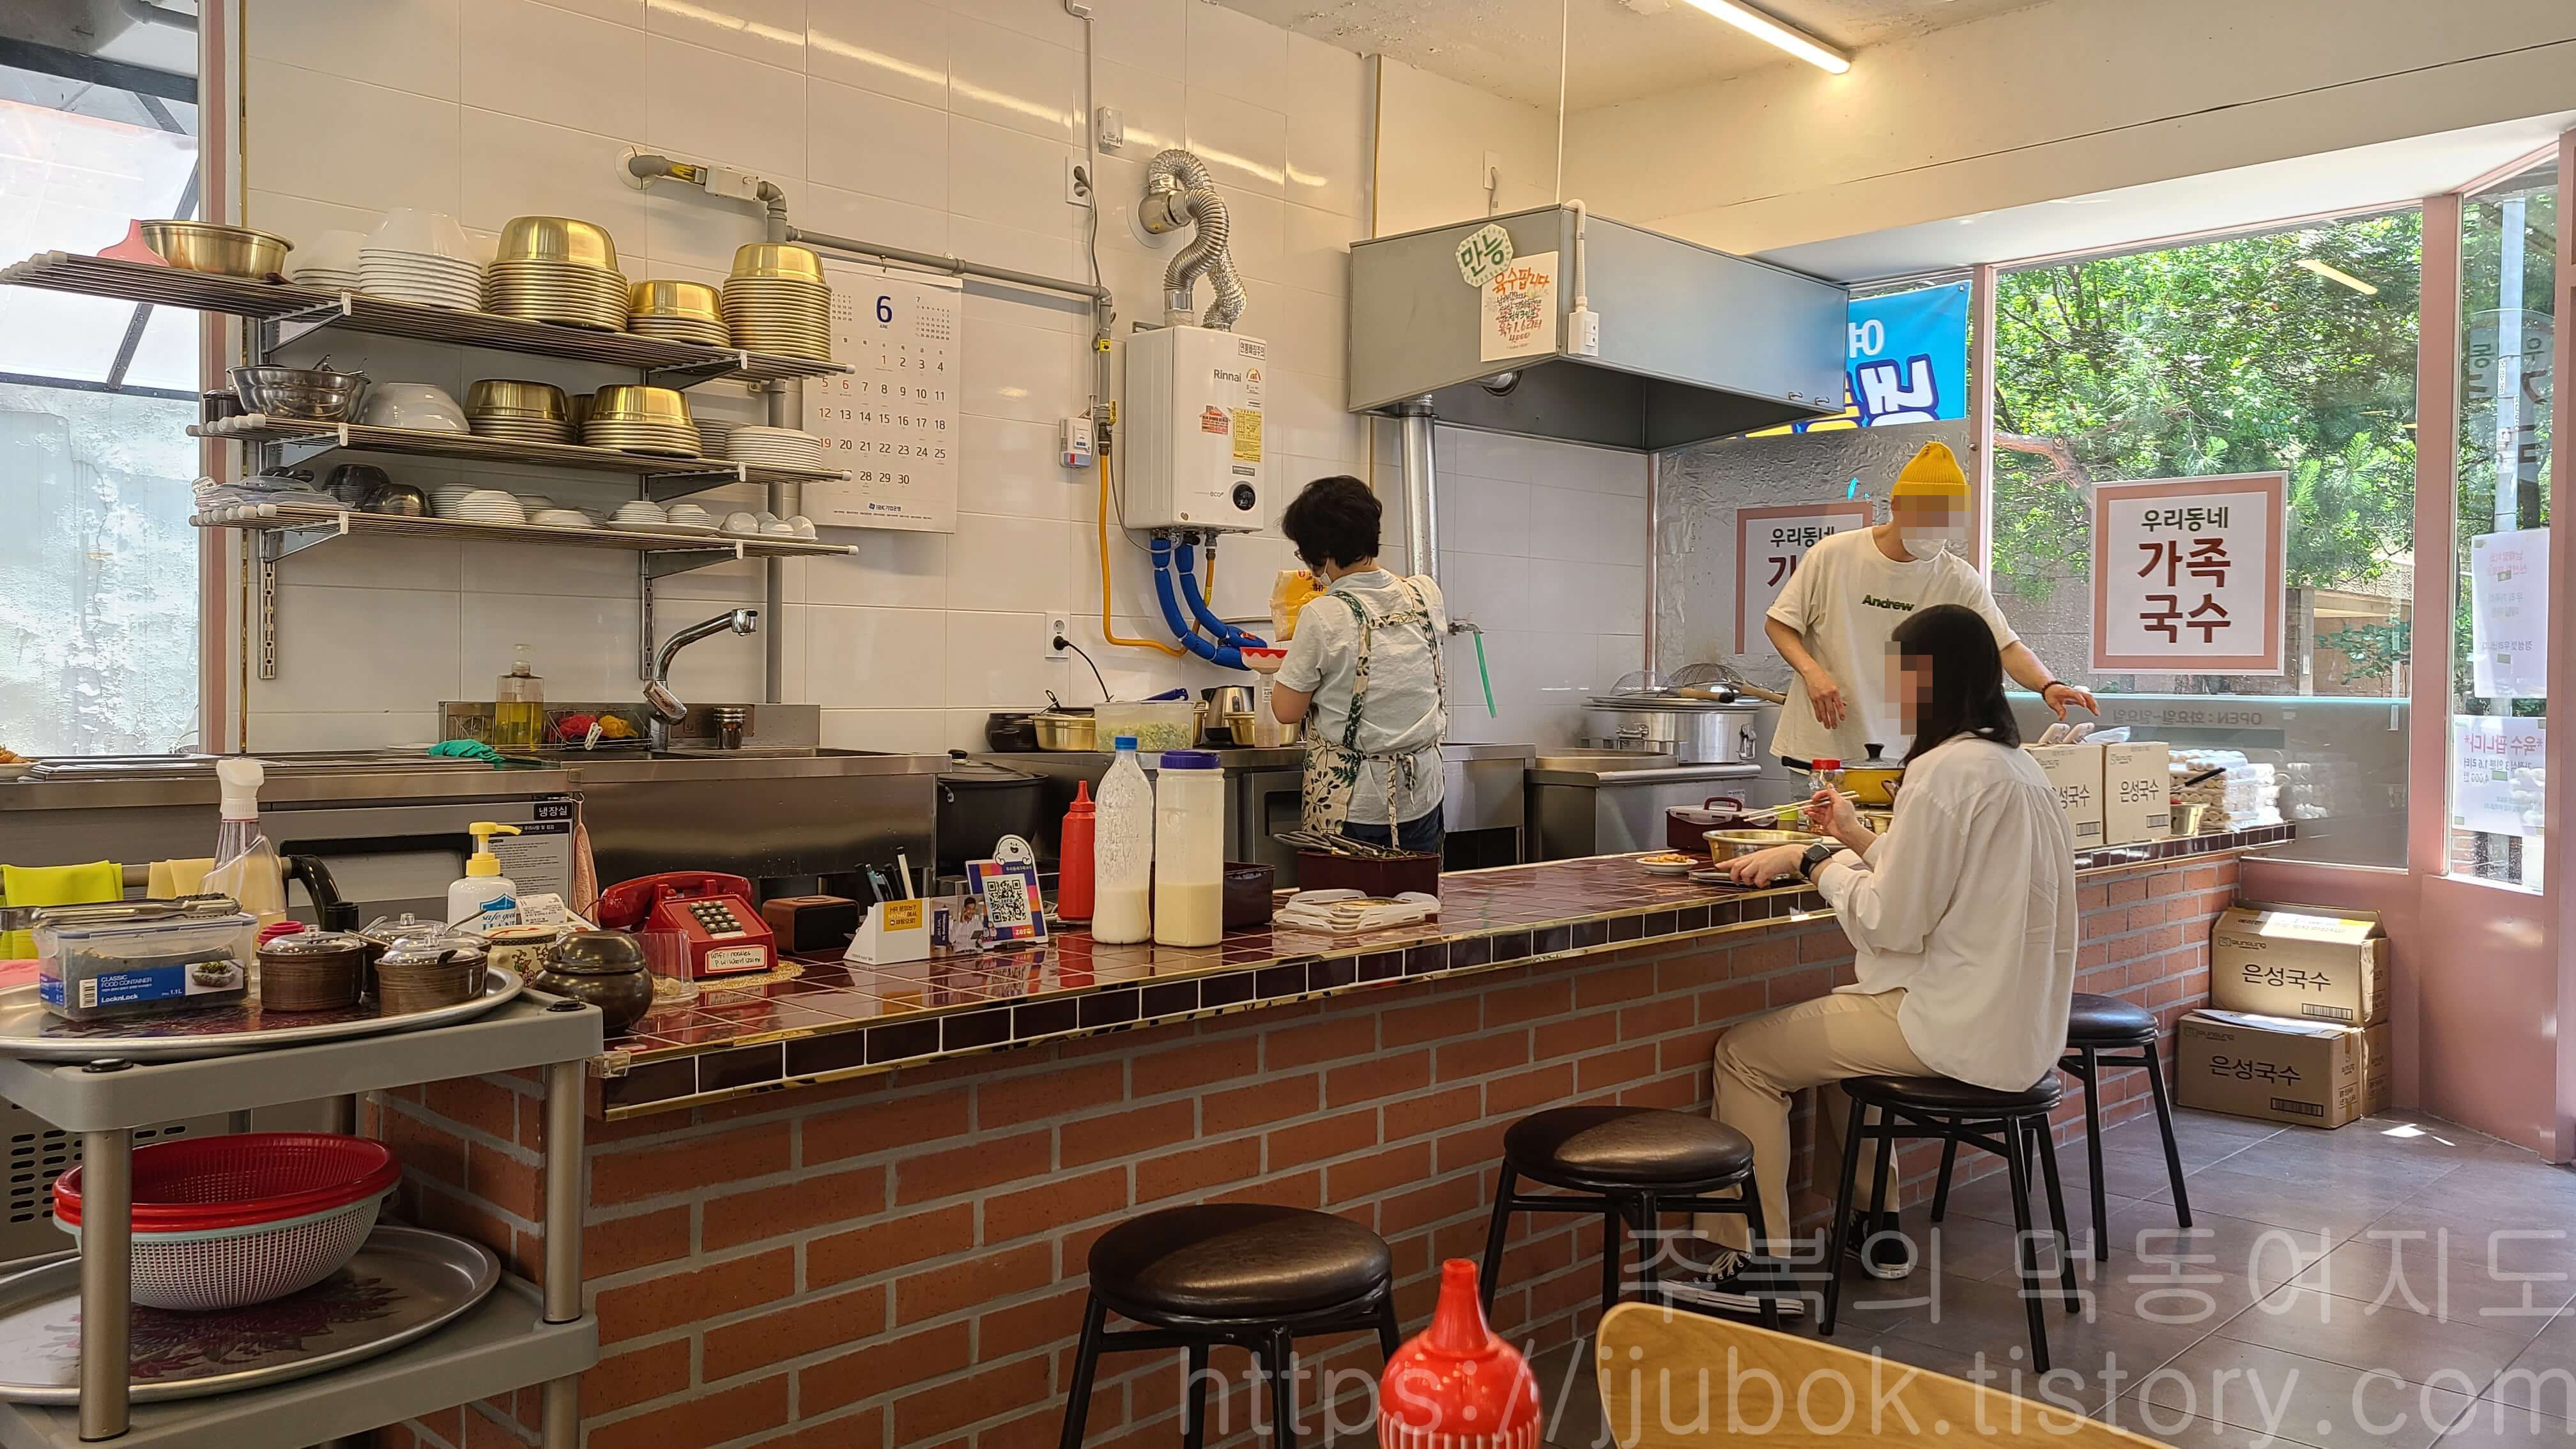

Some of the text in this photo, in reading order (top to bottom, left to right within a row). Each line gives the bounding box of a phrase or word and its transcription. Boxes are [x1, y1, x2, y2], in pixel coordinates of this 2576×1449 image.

[1461, 234, 1503, 277] 만능
[1492, 267, 1550, 295] 육수팝니다
[876, 296, 893, 323] 6
[882, 355, 944, 372] 1 2 3 4
[1214, 369, 1241, 383] Rinnai
[822, 377, 945, 401] 5 6 7 8 9 10 11
[819, 407, 946, 430] 12 13 14 15 16 17 18
[820, 438, 946, 459] 19 20 21 22 23 24 25
[859, 470, 910, 486] 28 29 30
[2142, 507, 2229, 532] 우리동네
[2138, 538, 2230, 588] 가족
[1862, 595, 1915, 612] Andrew
[2140, 593, 2230, 643] 국수
[2052, 785, 2090, 809] 성국수
[2120, 779, 2159, 802] 은성국수
[539, 806, 567, 817] 냉장실
[119, 977, 152, 986] CONTAINER
[2242, 963, 2331, 992] 은성국수
[101, 993, 138, 1003] LocknLock
[2209, 1055, 2301, 1086] 은성국수
